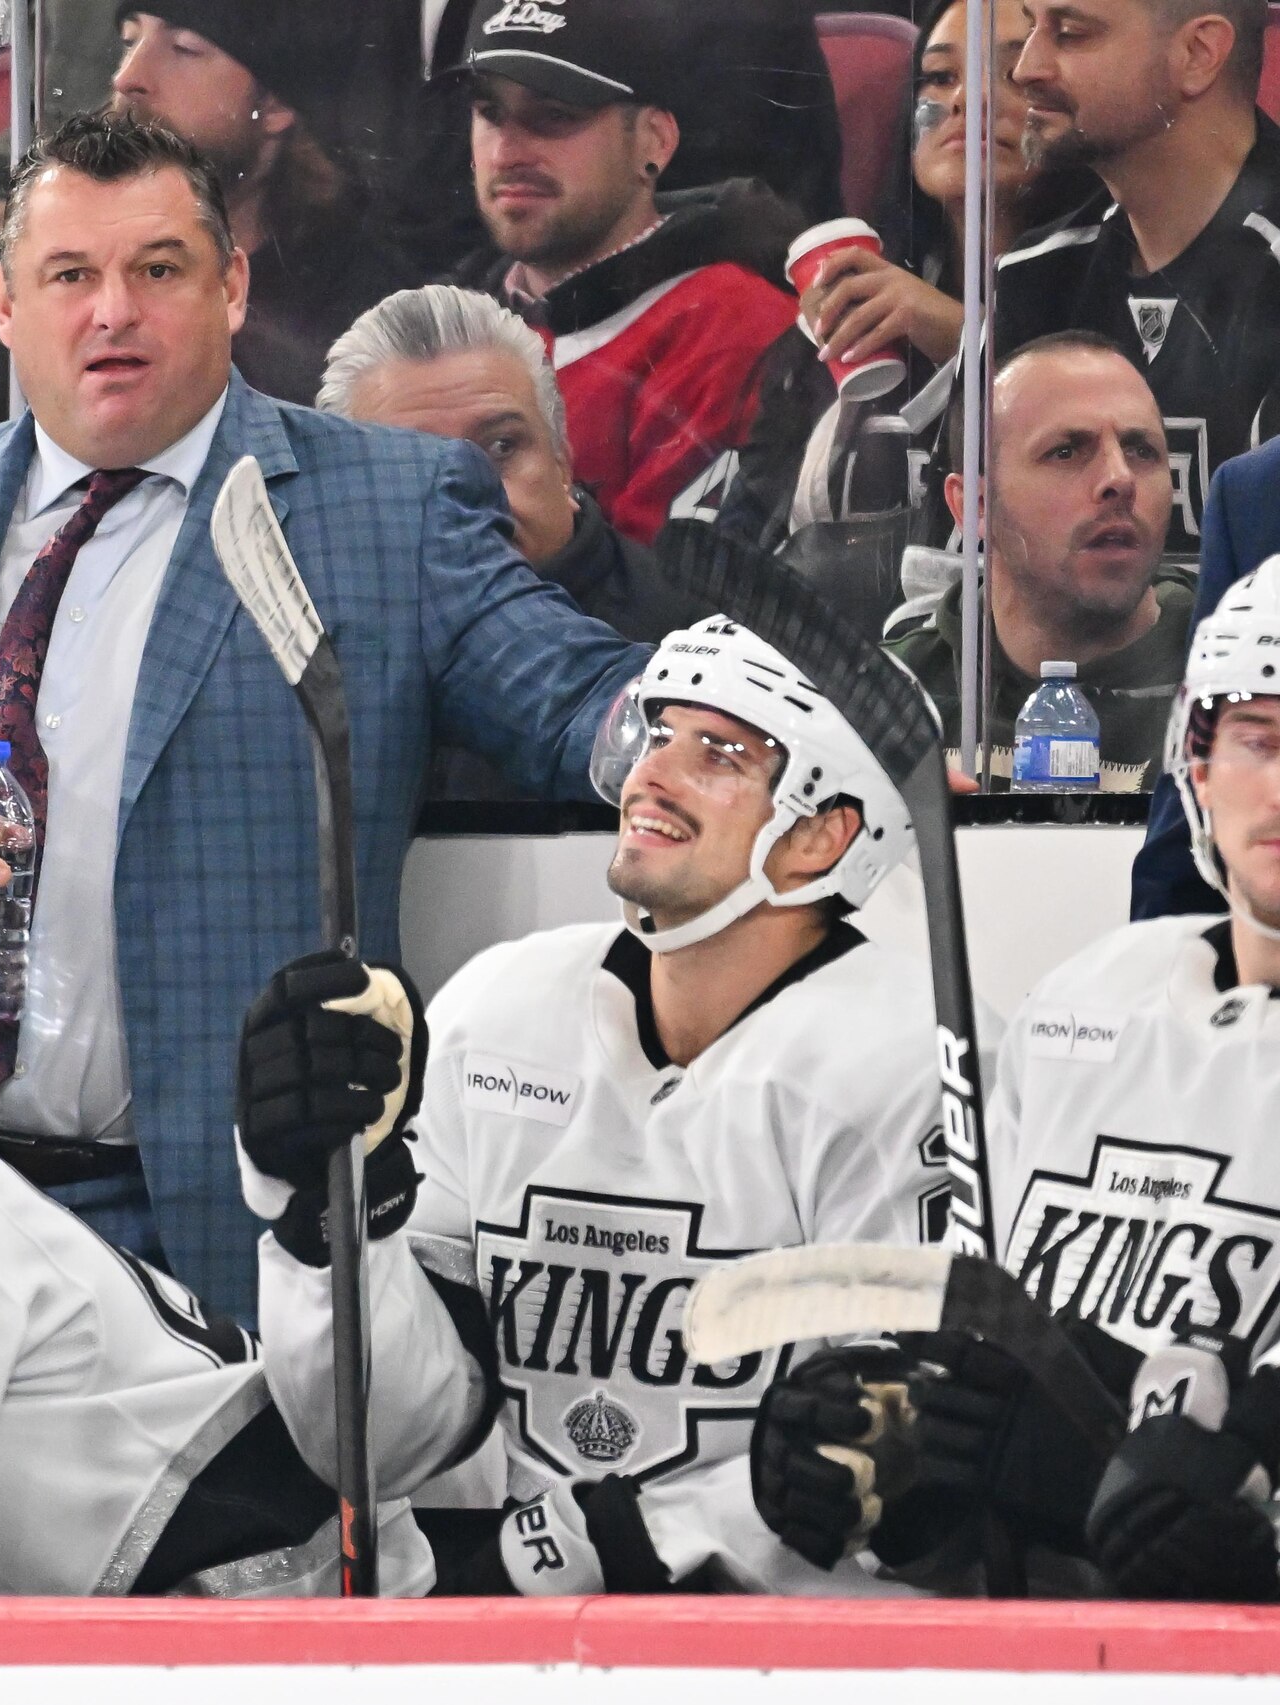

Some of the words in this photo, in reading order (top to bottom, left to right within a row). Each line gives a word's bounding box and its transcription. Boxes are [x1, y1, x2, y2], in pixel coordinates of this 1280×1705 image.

[1030, 1022, 1071, 1039] IRON
[1075, 1025, 1118, 1042] BOW
[467, 1072, 512, 1093] IRON
[519, 1082, 571, 1105] BOW
[1108, 1171, 1137, 1195] Los
[544, 1219, 580, 1245] Los
[583, 1224, 670, 1257] Angeles
[1020, 1204, 1274, 1336] KINGS
